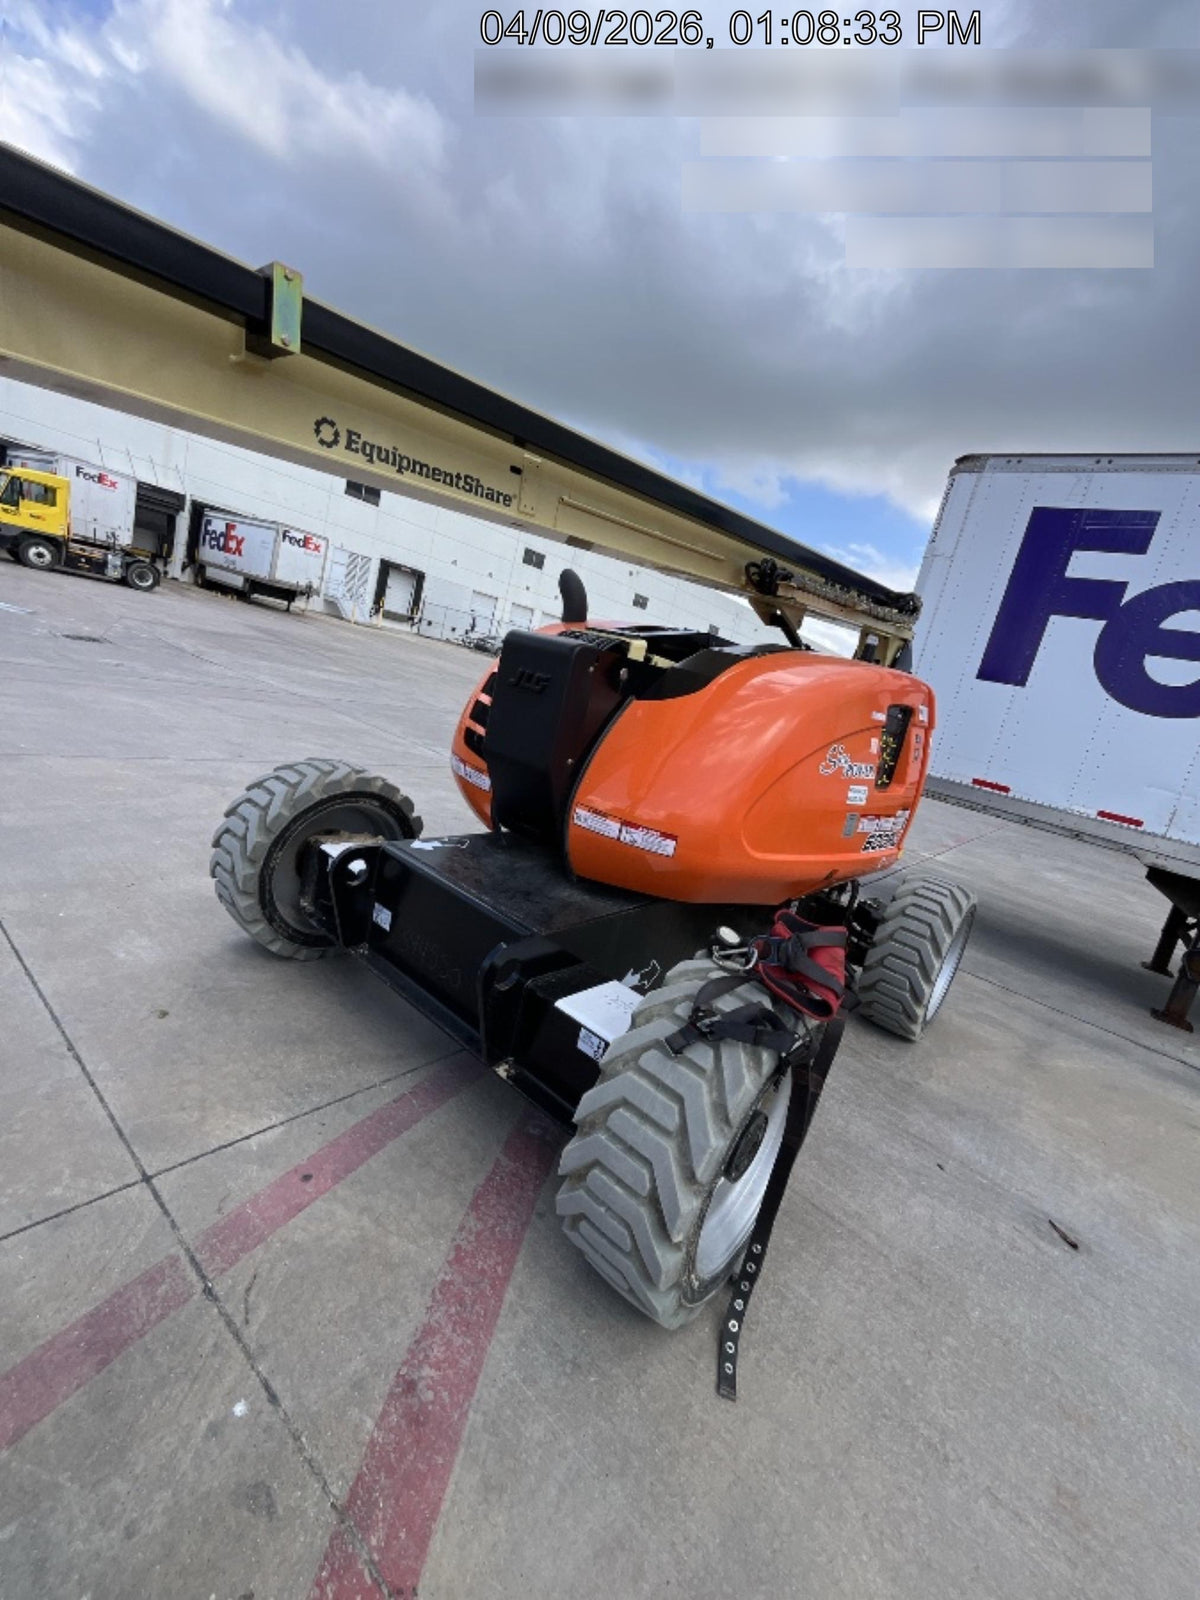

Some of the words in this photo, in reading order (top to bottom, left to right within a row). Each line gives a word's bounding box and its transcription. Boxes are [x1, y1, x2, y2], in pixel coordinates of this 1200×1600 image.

[75, 465, 118, 490] FedEx
[344, 428, 513, 508] EquipmentShare
[202, 518, 246, 558] FedEx
[281, 529, 321, 554] FedEx
